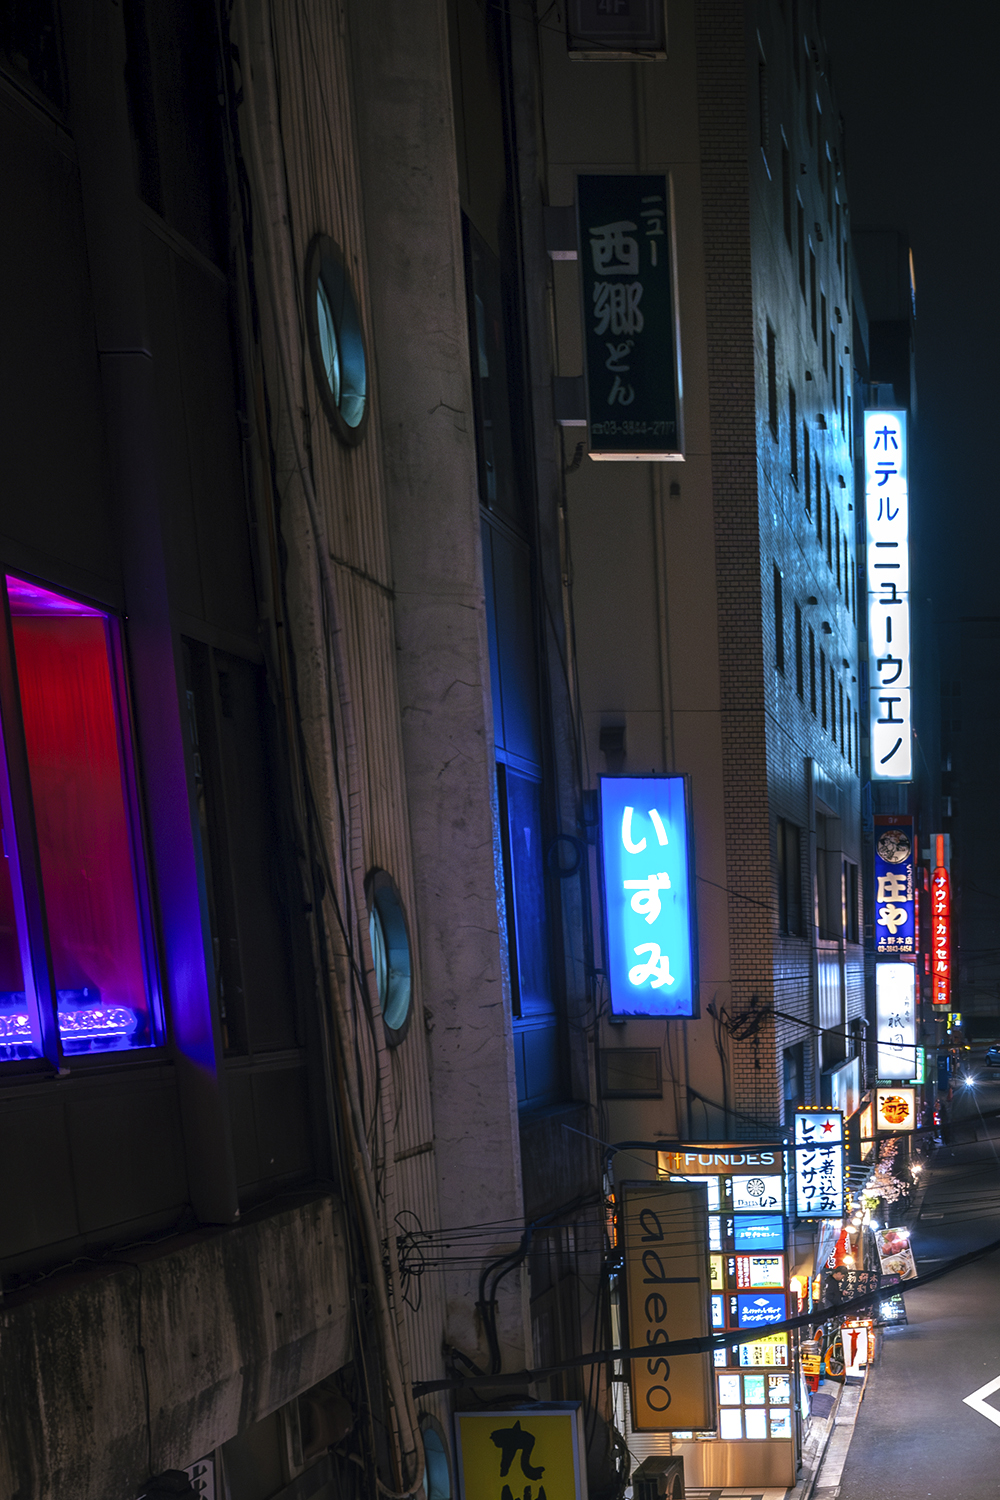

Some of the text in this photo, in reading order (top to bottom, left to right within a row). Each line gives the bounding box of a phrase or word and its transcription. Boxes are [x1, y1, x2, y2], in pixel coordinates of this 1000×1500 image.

[640, 195, 665, 268] ニュー
[588, 220, 644, 406] 西郷どん
[873, 425, 905, 765] ホテル ニューウエノ
[621, 806, 675, 989] いずみ
[877, 872, 908, 934] 庄や
[878, 936, 913, 945] 上野本店
[935, 876, 947, 972] サウナ・カプセル
[684, 1151, 775, 1166] FUNDES
[800, 1118, 817, 1212] レモンサワー
[638, 1208, 699, 1413] adesso
